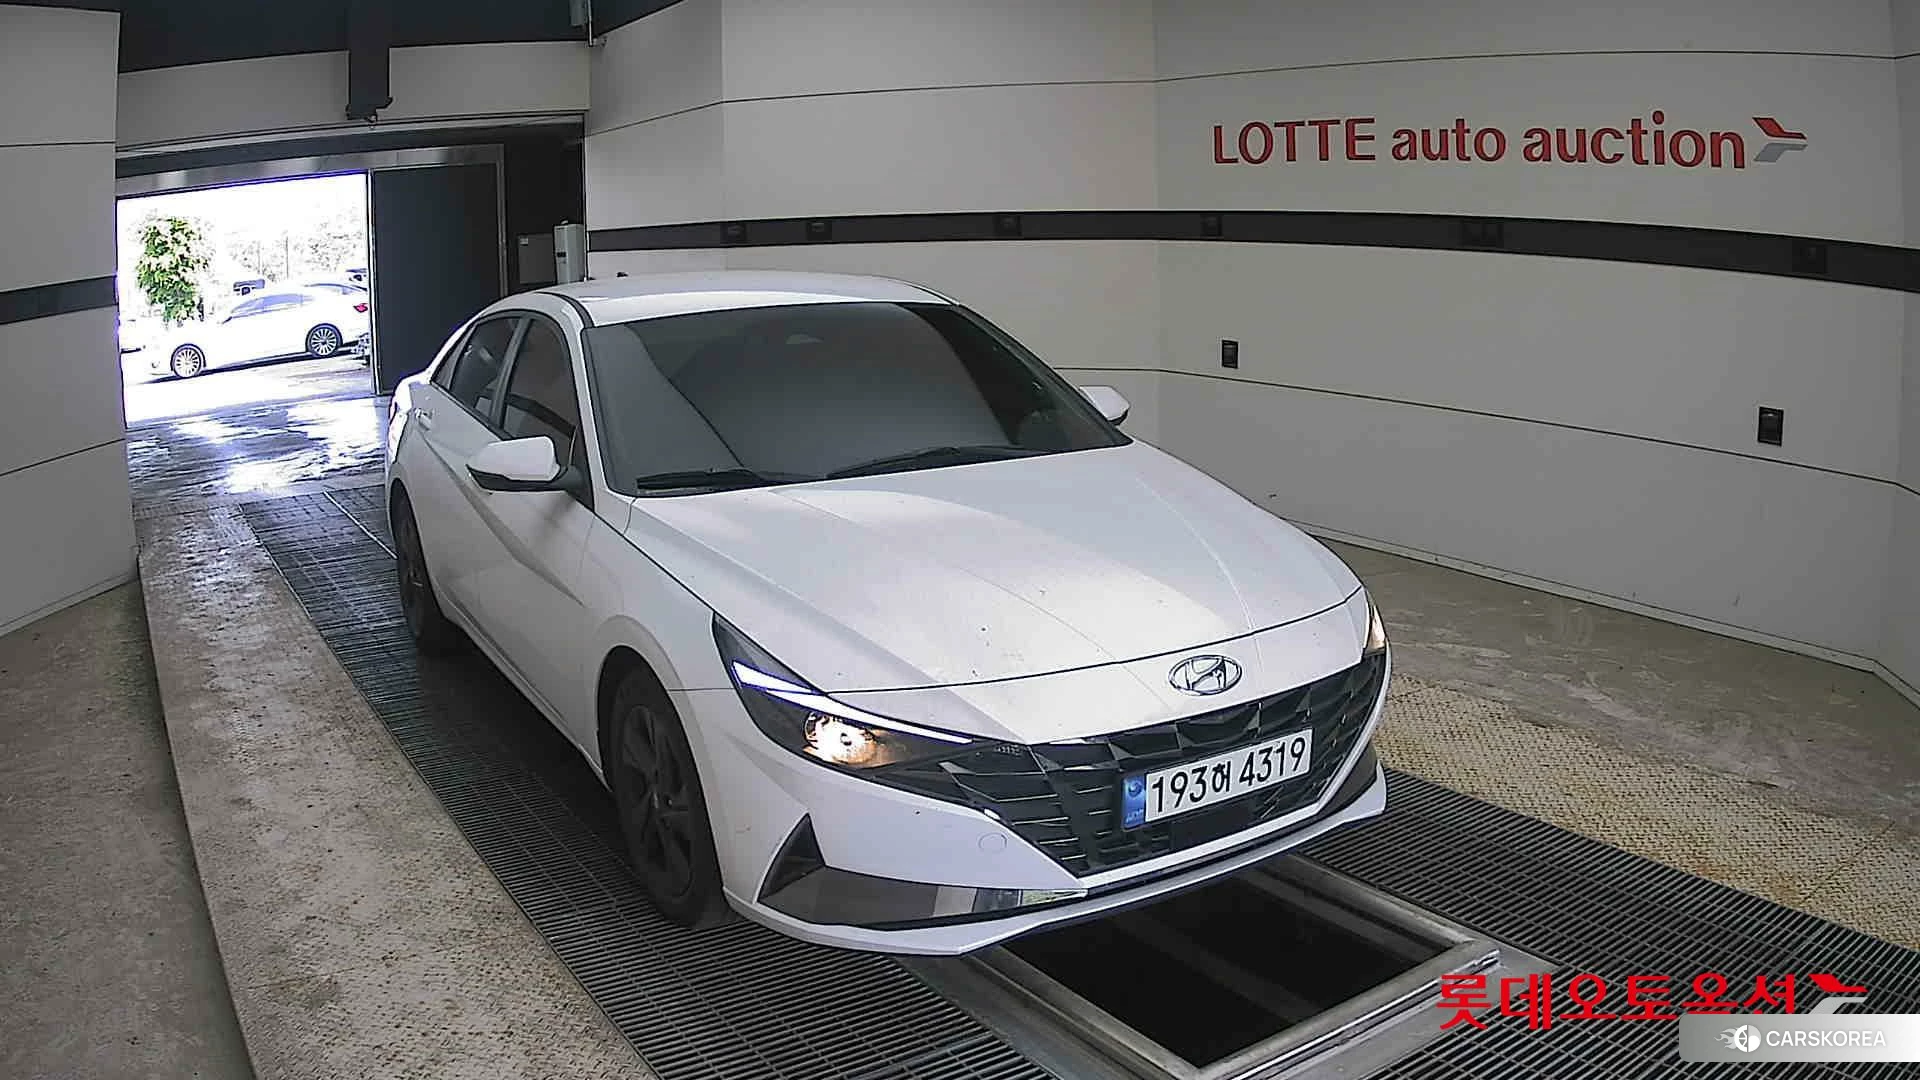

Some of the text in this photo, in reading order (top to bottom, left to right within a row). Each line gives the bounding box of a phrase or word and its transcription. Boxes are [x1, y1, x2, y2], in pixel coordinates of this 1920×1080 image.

[1212, 110, 1746, 169] LOTTE auto auction
[1151, 737, 1307, 813] 193허 4319
